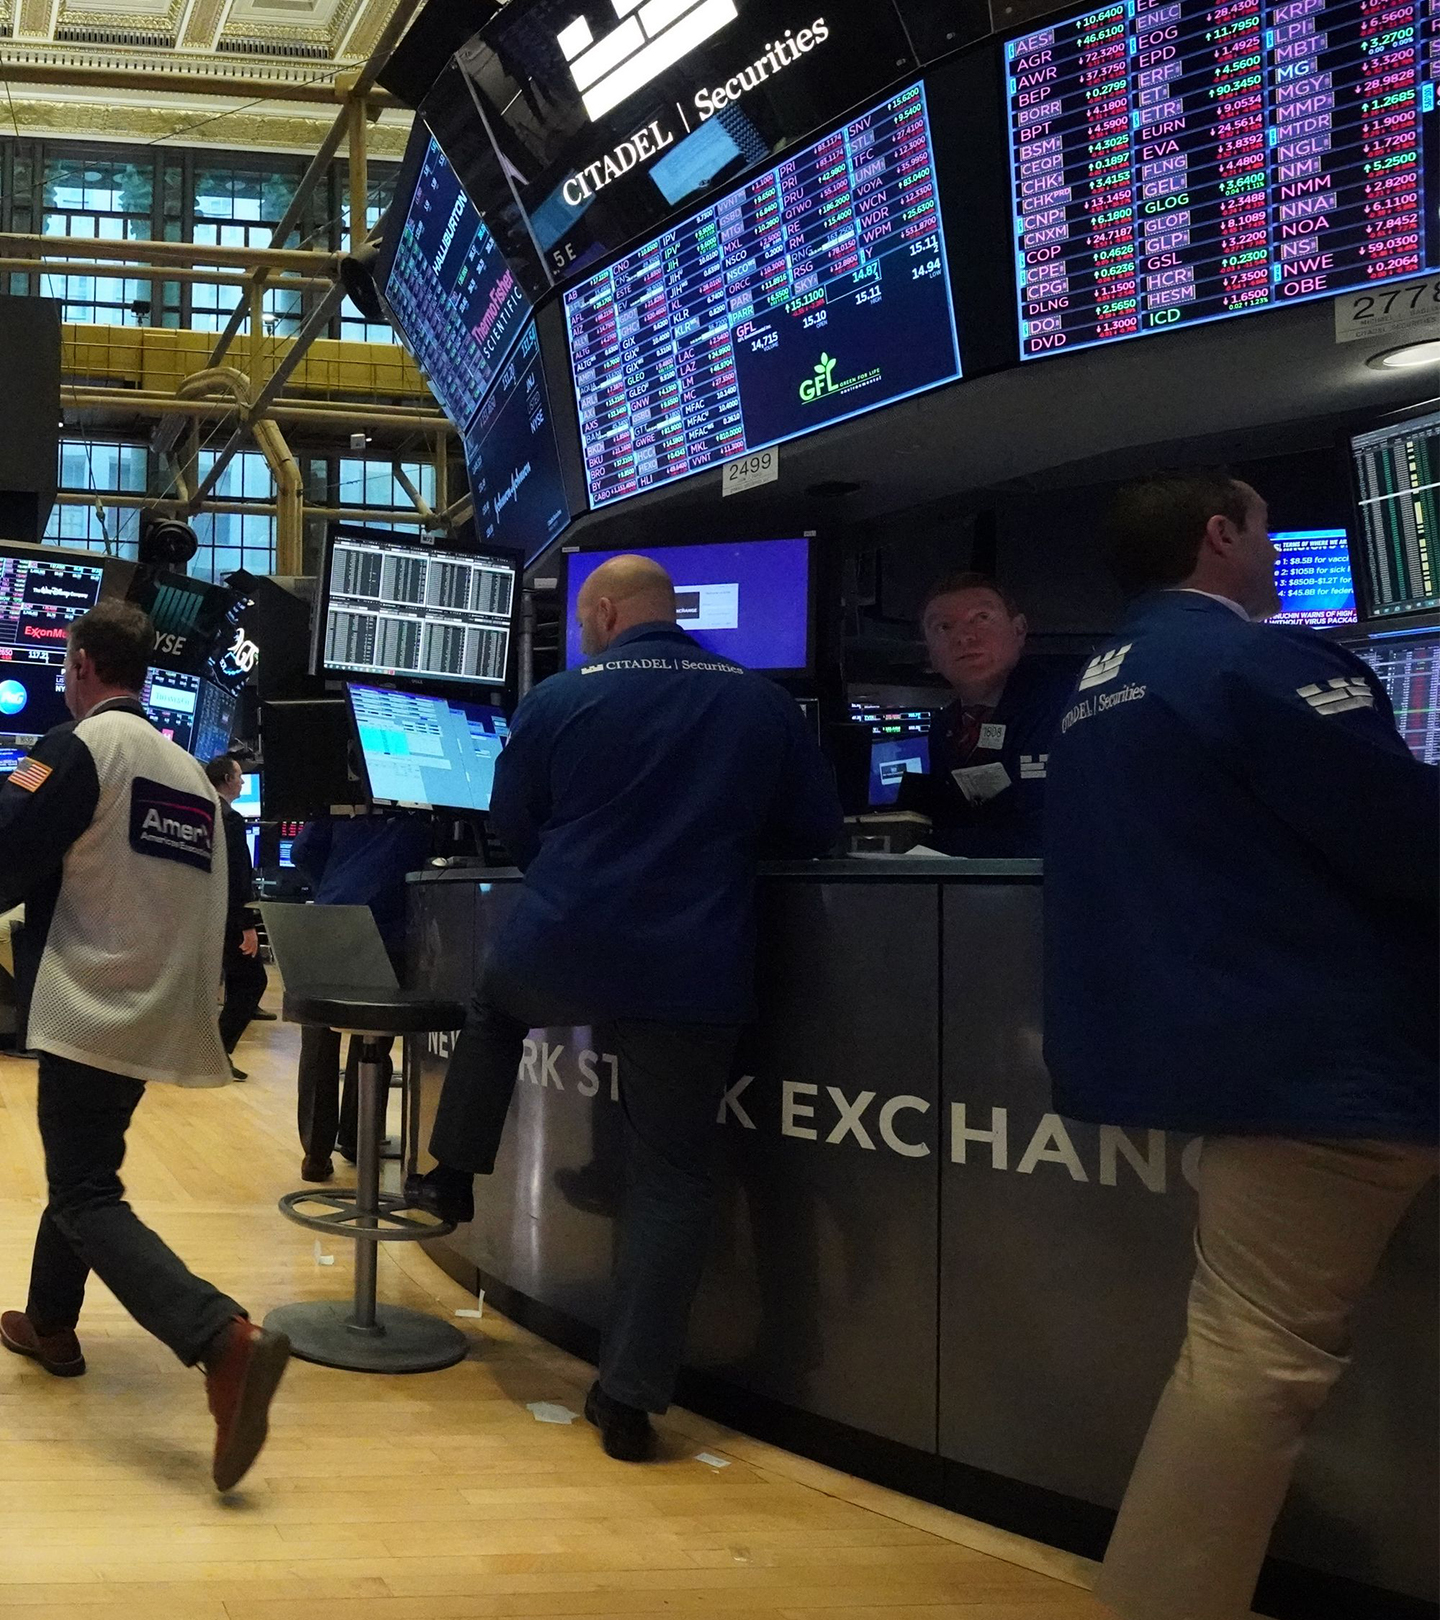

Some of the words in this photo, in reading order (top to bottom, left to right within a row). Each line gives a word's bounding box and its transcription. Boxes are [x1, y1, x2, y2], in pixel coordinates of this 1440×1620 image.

[1015, 34, 1048, 54] AES
[1083, 6, 1124, 27] 10.6400
[1139, 25, 1178, 49] EOG
[1214, 17, 1260, 40] 11.7950
[1017, 50, 1052, 72] AGR
[1083, 25, 1124, 45] 46.6100
[1139, 46, 1176, 68] EPD
[1222, 36, 1260, 56] 1.4925
[1018, 67, 1057, 90] AWR
[1085, 43, 1125, 63] 72.3200
[1278, 76, 1325, 102] MGY
[1371, 48, 1415, 69] 3.3200
[1019, 87, 1051, 107] BEP
[1086, 62, 1126, 81] 37.3750
[1020, 101, 1060, 123] BORR
[1092, 80, 1127, 97] 0.2799
[562, 120, 674, 207] CITADEL
[693, 17, 830, 122] Securities
[848, 116, 872, 137] SNV
[1020, 121, 1052, 142] BPT
[1093, 98, 1128, 115] 4.1800
[1142, 117, 1186, 140] EURN
[1224, 94, 1262, 113] 9.0534
[1279, 114, 1329, 140] MTDR
[1371, 89, 1416, 111] 1.2685
[1143, 140, 1179, 160] EVA
[1217, 114, 1263, 134] 24.5614
[853, 150, 875, 167] TFC
[1281, 175, 1331, 199] NMM
[1373, 152, 1417, 171] 5.2500
[783, 189, 805, 206] PRU
[856, 177, 884, 197] VOYA
[859, 191, 887, 212] WCN
[1145, 193, 1189, 214] GLOG
[1227, 172, 1265, 190] 3.6400
[785, 199, 812, 219] QTWO
[861, 206, 889, 228] WDR
[1282, 216, 1330, 238] NOA
[1373, 193, 1418, 211] 6.1100
[432, 190, 468, 276] HALLIBURTON
[863, 221, 892, 243] WPM
[1027, 245, 1061, 265] COP
[1093, 226, 1133, 244] 24.7187
[725, 250, 747, 267] NSCO
[1147, 252, 1183, 270] GSL
[1229, 230, 1267, 247] 3.2200
[1283, 254, 1334, 278] NWE
[1368, 234, 1418, 253] 59.0300
[729, 278, 751, 294] ORCC
[793, 263, 814, 279] RSG
[852, 263, 878, 283] 14.87
[911, 258, 941, 280] 14.94
[1028, 280, 1062, 299] CPG
[1100, 263, 1134, 278] 0.6236
[1284, 275, 1328, 296] OBE
[1376, 254, 1418, 273] 0.2064
[791, 287, 825, 313] 15.1100
[855, 285, 882, 306] 15.11
[1029, 297, 1069, 315] DLNG
[1101, 281, 1136, 296] 1.1500
[1150, 308, 1180, 326] ICD
[1231, 288, 1268, 304] 1.6500
[483, 286, 523, 359] SCIENTIFIC
[736, 320, 757, 339] GFL
[802, 310, 827, 329] 15.10
[1031, 333, 1067, 351] DVD
[1103, 317, 1137, 332] 1.3000
[751, 331, 779, 352] 14,715
[799, 366, 840, 402] GFL
[729, 452, 772, 481] 2499
[154, 631, 186, 656] YSE
[606, 658, 672, 671] CITADEL
[682, 660, 744, 675] Securities
[1098, 683, 1146, 711] Securities
[517, 1039, 565, 1091] RK
[780, 1079, 1202, 1196] EXCHAN
